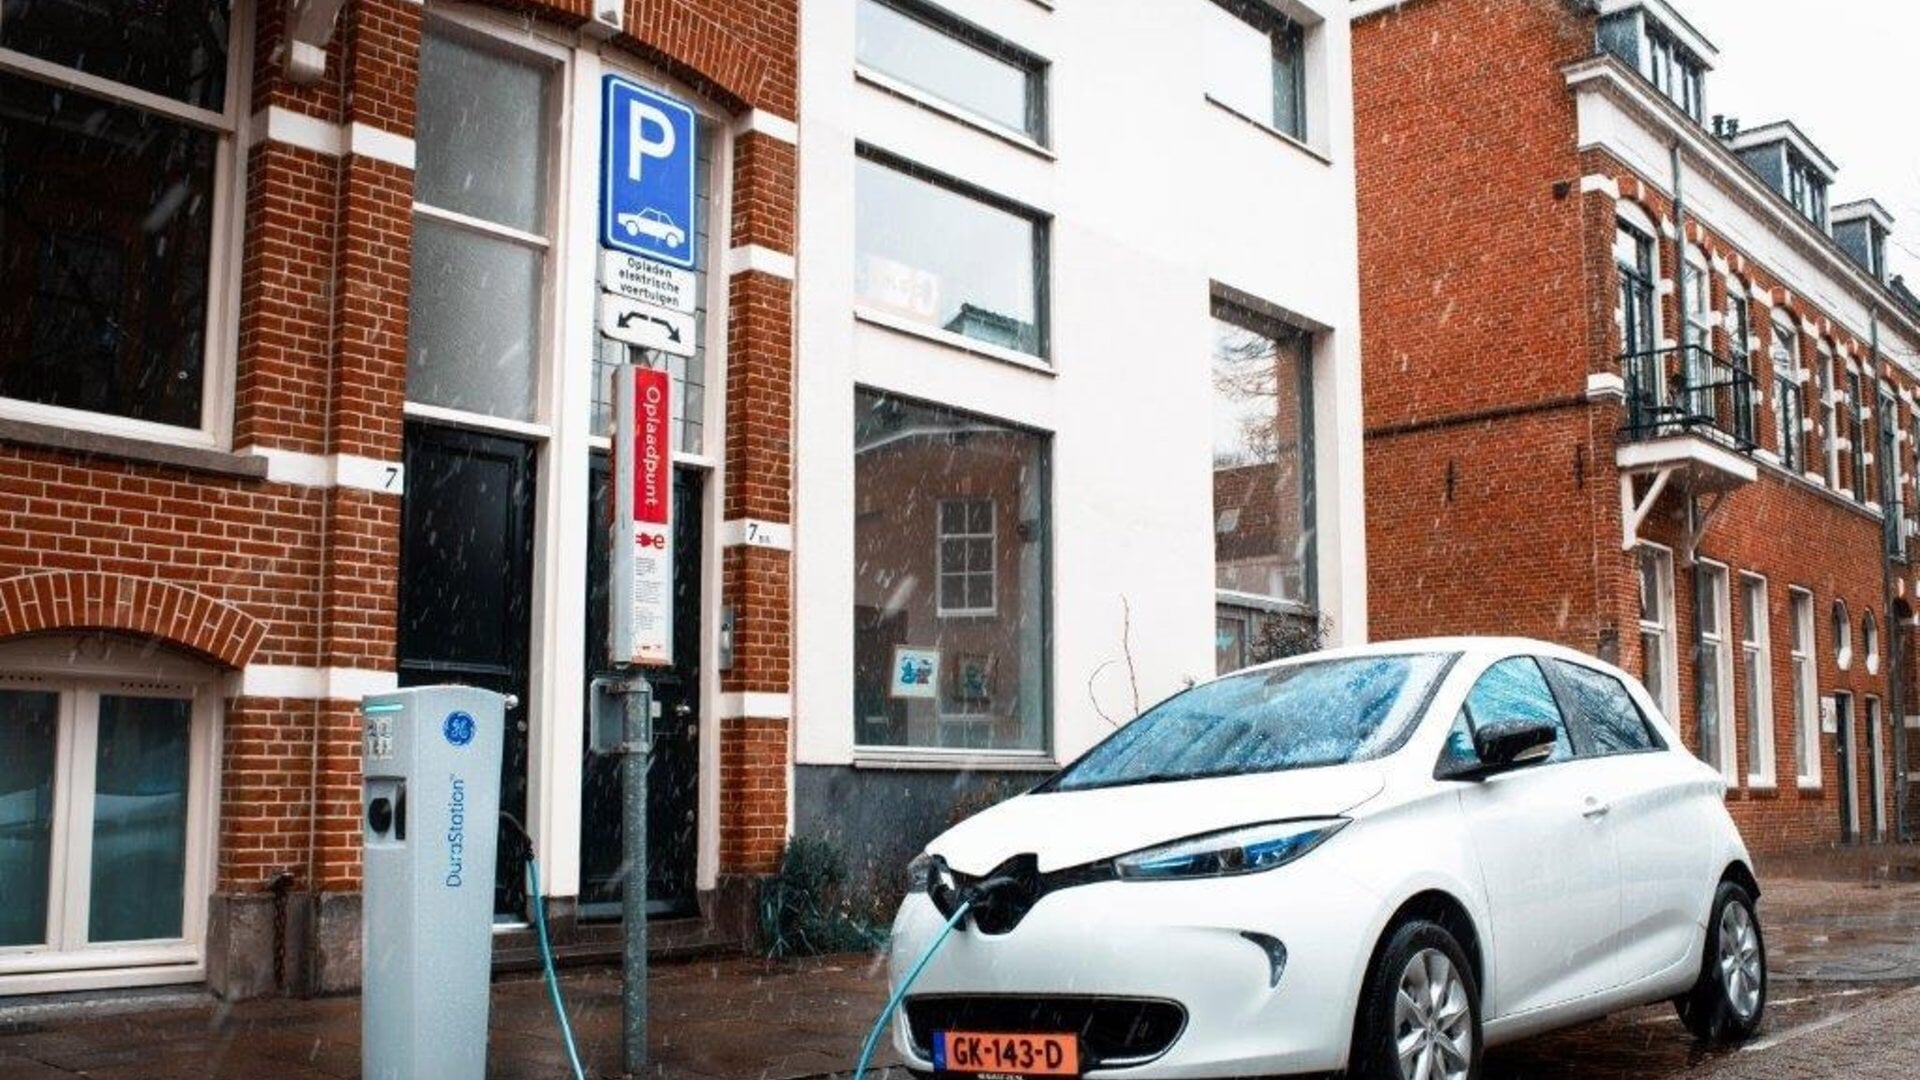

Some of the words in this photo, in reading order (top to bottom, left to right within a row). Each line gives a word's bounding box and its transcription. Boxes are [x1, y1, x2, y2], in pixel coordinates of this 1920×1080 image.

[628, 98, 676, 182] P
[627, 257, 673, 279] Opladen
[618, 269, 680, 294] elektrische
[620, 283, 680, 307] voertuigen
[643, 386, 662, 506] Oplaadpunt
[385, 467, 398, 489] 7
[749, 523, 759, 541] 7
[445, 778, 465, 888] DuraStation
[953, 1037, 1063, 1069] GK-143-D
